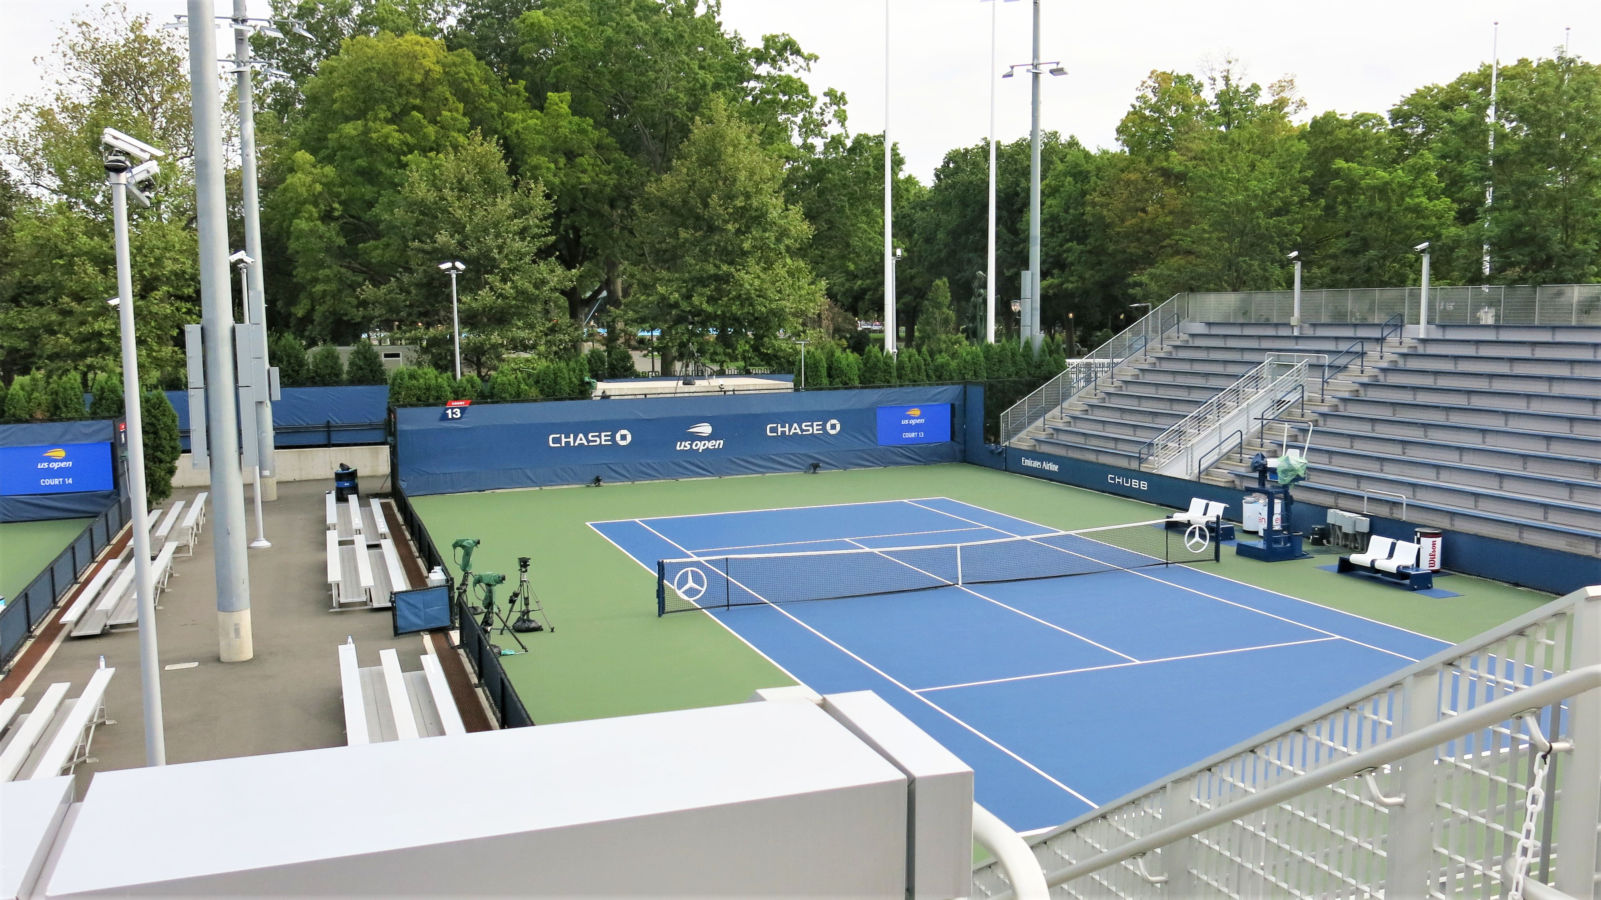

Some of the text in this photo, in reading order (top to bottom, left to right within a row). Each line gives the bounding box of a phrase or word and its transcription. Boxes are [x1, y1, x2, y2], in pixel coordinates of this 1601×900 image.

[445, 408, 461, 418] 13
[766, 421, 823, 436] CHASE
[548, 432, 612, 447] CHASE
[676, 438, 724, 452] us open
[49, 461, 72, 470] open
[1021, 457, 1059, 472] Emirates Airline
[40, 478, 63, 486] COURT
[1107, 474, 1148, 490] CHUBB
[1428, 540, 1437, 568] Wilson
